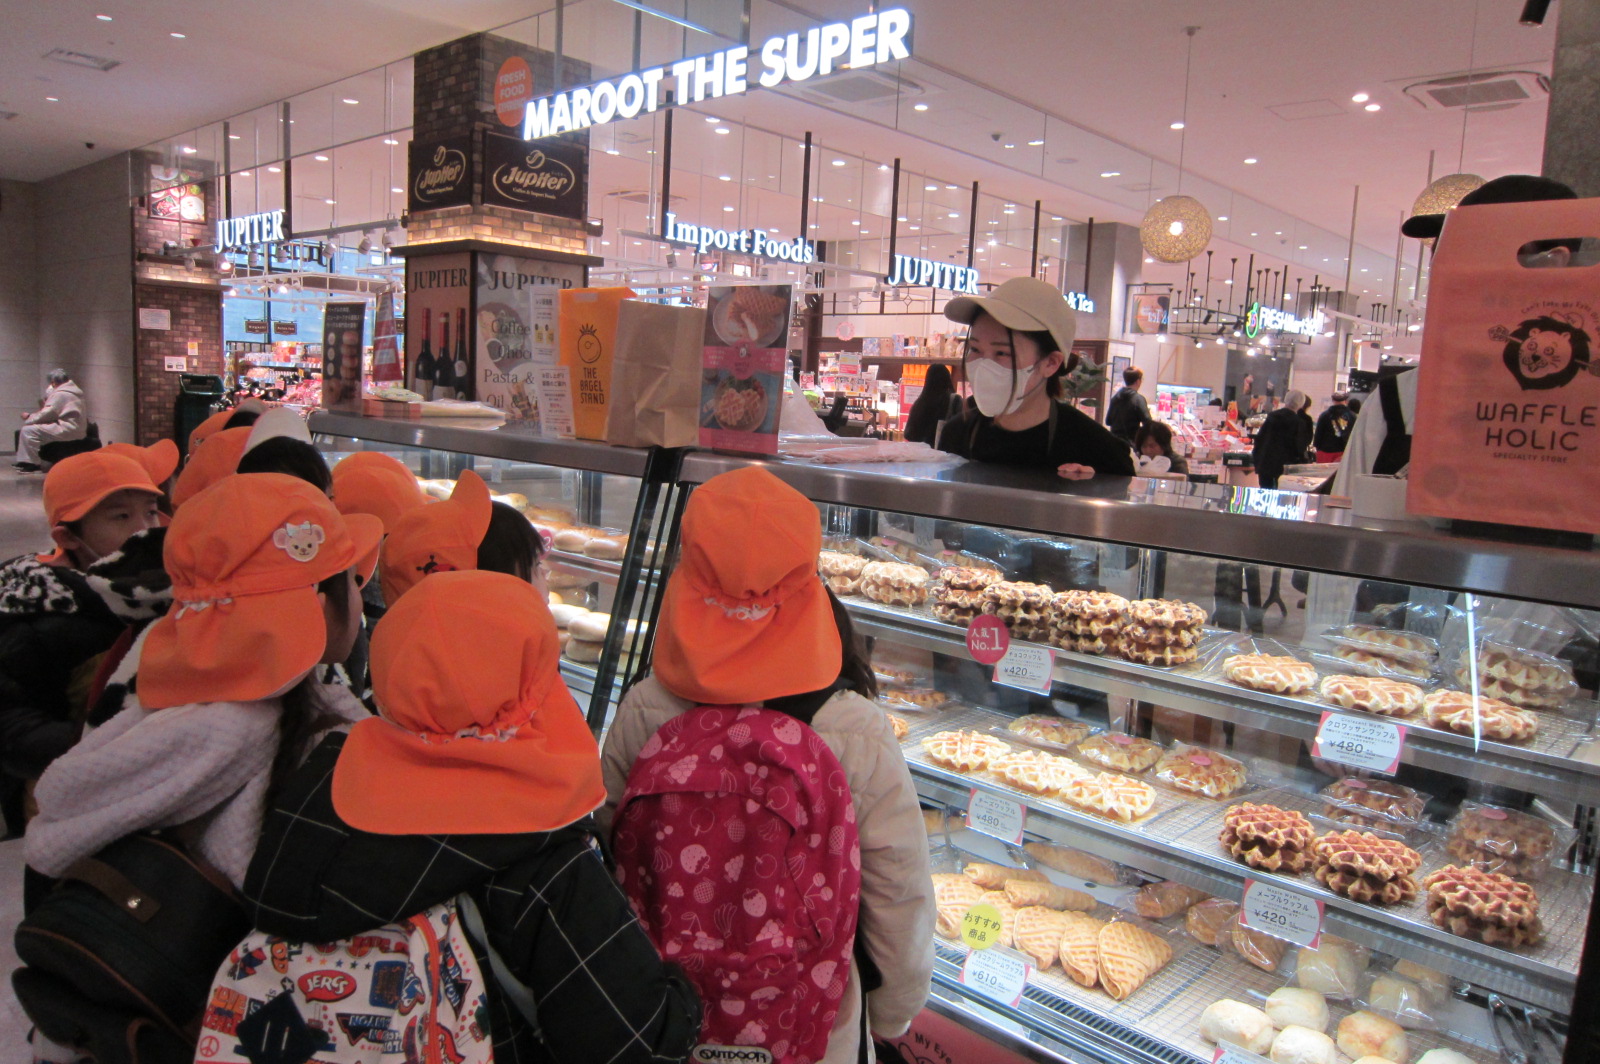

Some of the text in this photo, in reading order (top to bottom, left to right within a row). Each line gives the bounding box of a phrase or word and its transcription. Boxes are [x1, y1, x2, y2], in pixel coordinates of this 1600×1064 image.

[500, 70, 526, 85] FRESH
[523, 8, 911, 141] MAROOT THE SUPER
[501, 84, 525, 99] FOOD
[420, 165, 461, 189] Jupiter
[502, 167, 568, 191] Jupiter
[215, 210, 285, 253] JUPITER
[666, 213, 813, 263] Import Foods
[411, 268, 468, 293] JUPITER
[889, 254, 979, 294] JUPITER
[1077, 293, 1093, 313] Tea
[492, 319, 531, 336] Coffee
[484, 369, 518, 383] Pasta
[526, 372, 534, 384] &
[583, 367, 597, 379] THE
[580, 379, 604, 392] BAGEL
[487, 394, 504, 408] Oil
[580, 392, 605, 405] STAND
[1476, 402, 1598, 427] WAFFLE
[1485, 427, 1579, 451] HOLIC
[1493, 452, 1568, 463] SPECIALTY STORE
[971, 627, 990, 638] 人気
[1009, 652, 1041, 661] チョコワッフル
[1004, 666, 1028, 676] ¥420
[1327, 720, 1396, 739] クロワッサンワッフル
[1329, 740, 1364, 754] ¥480
[976, 813, 1000, 827] ¥480
[1257, 891, 1309, 911] メープルワッフル
[964, 912, 1001, 931] おすすめ
[1254, 909, 1287, 925] ¥420
[968, 928, 987, 942] 商品
[973, 951, 1024, 976] チョコクリームワッフル
[972, 970, 998, 985] ¥610
[915, 1033, 931, 1049] My
[699, 1049, 767, 1063] OUTDOOR
